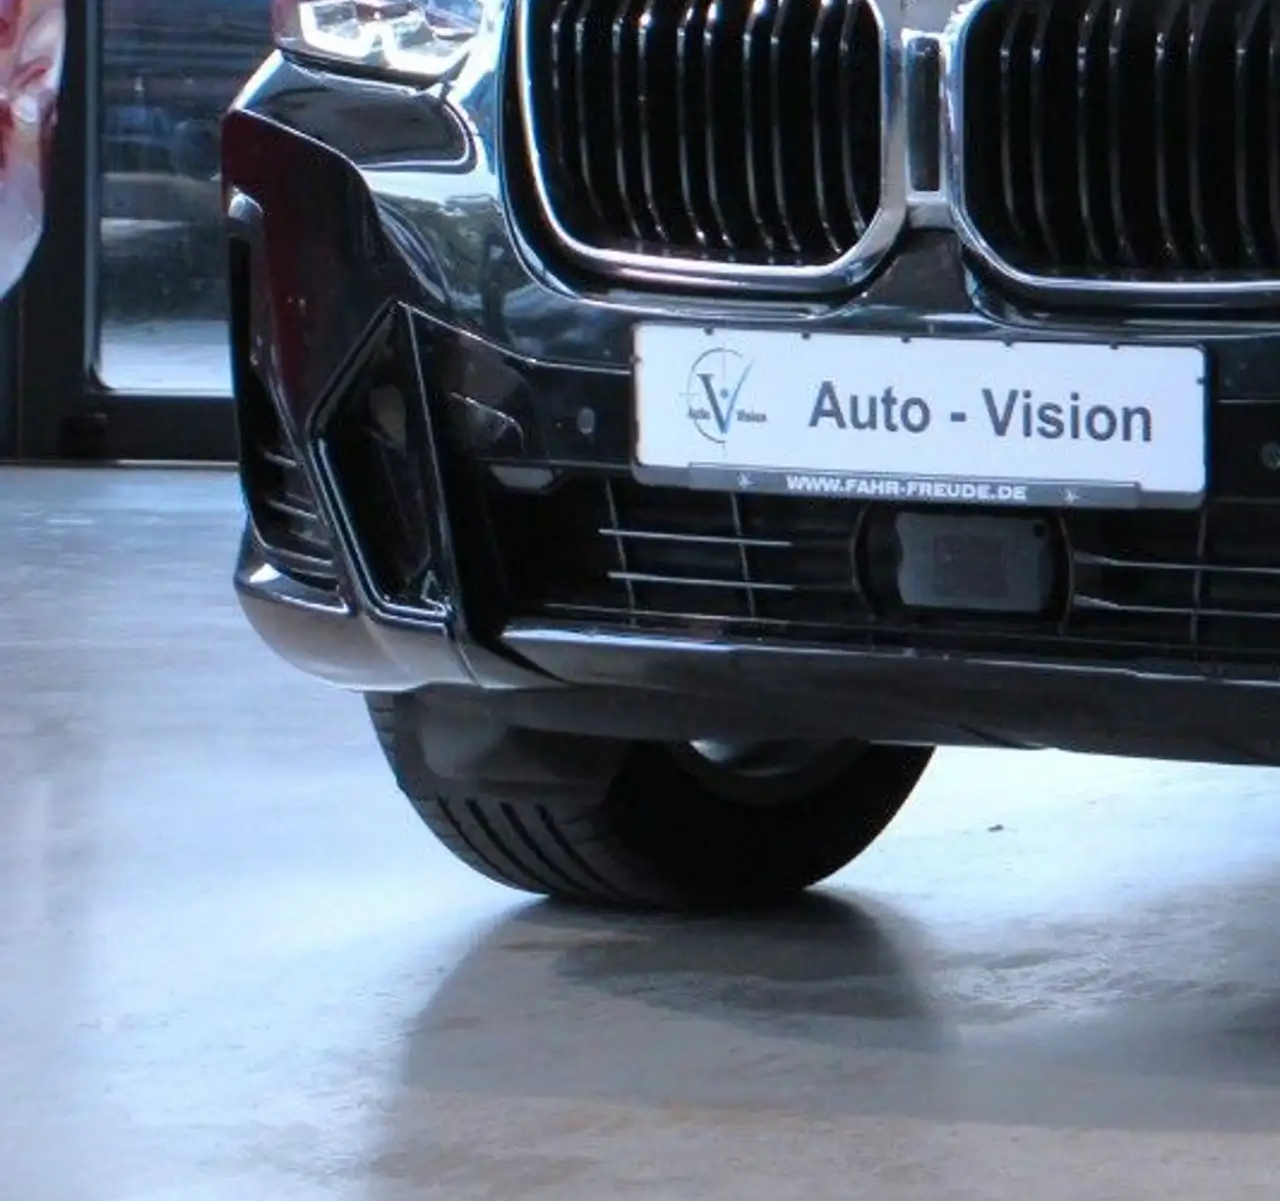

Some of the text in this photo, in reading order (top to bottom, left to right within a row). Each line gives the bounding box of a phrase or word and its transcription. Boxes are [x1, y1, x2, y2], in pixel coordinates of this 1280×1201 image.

[809, 380, 1153, 442] Auto - Vision
[785, 474, 1028, 501] WWW.FAHR-FREUDE.DE
